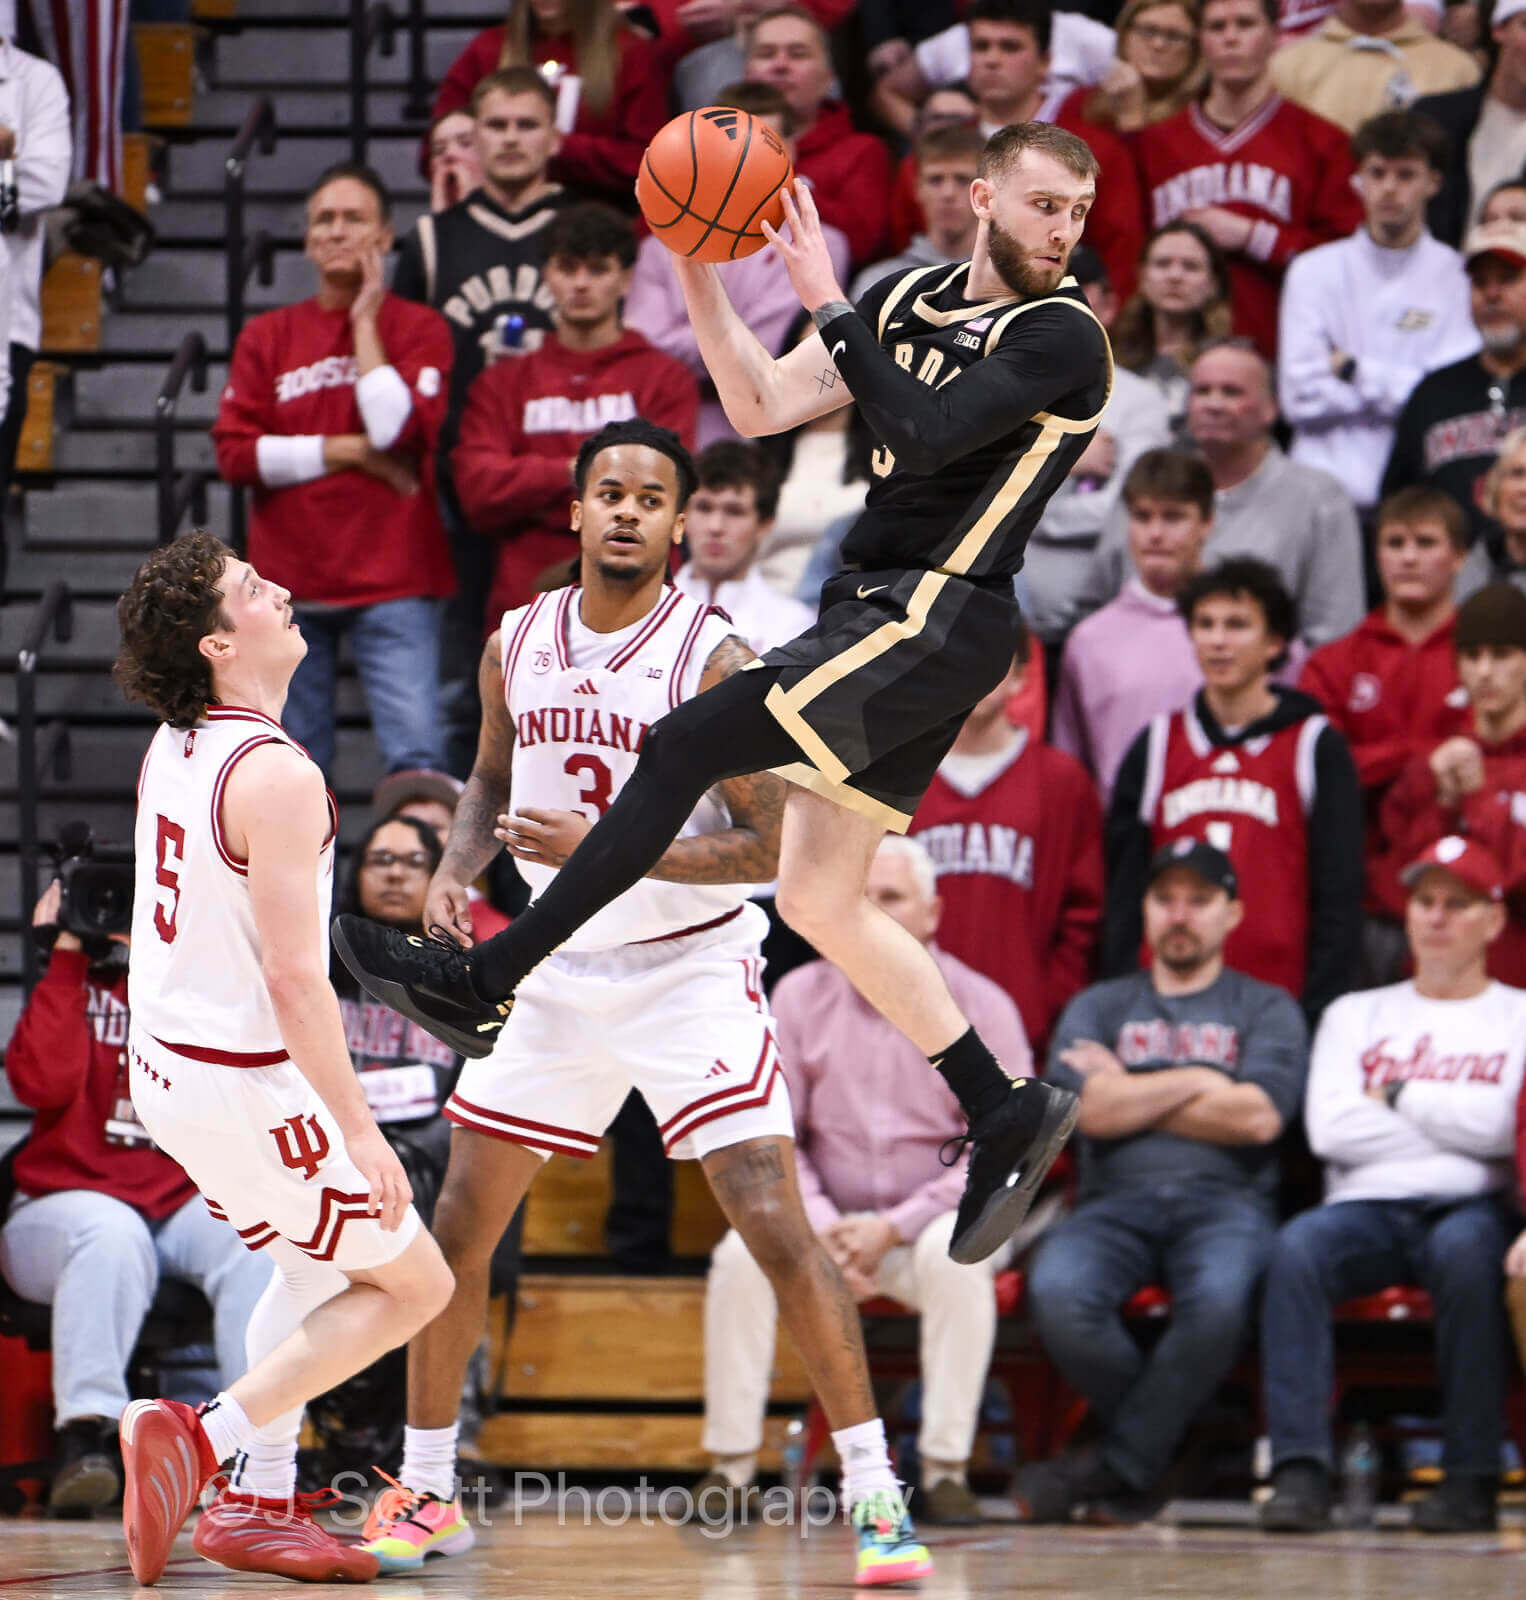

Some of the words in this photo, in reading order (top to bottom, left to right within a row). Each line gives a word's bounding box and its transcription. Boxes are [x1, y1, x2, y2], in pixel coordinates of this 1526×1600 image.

[533, 651, 550, 667] 76
[564, 753, 612, 819] 3
[1163, 777, 1279, 828] INDIANA
[154, 814, 186, 944] 5
[913, 821, 1034, 892] DIANA
[1360, 1033, 1507, 1093] Indiana
